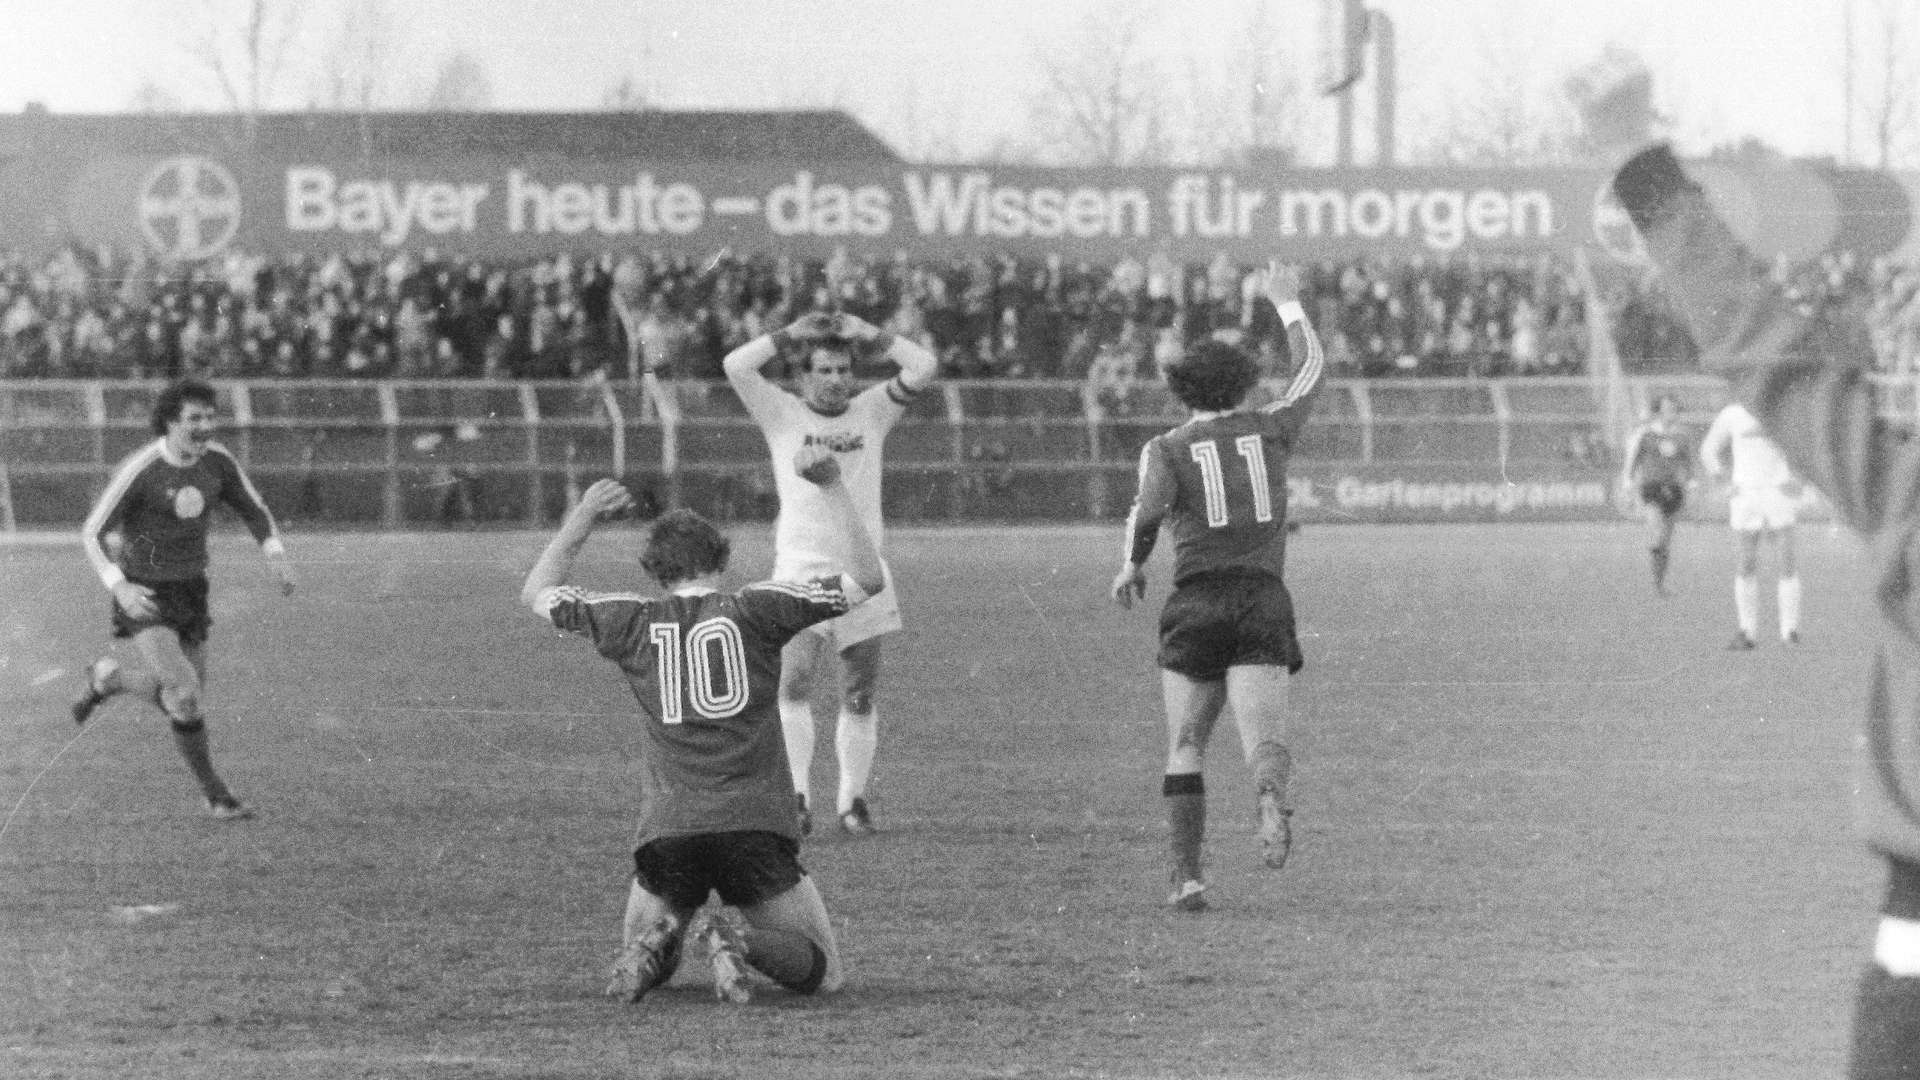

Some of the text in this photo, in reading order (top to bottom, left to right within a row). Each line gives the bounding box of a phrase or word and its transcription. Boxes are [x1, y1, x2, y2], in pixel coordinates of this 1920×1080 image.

[286, 168, 490, 245] Bayer
[506, 168, 704, 235] heute
[766, 170, 892, 236] das
[903, 172, 1152, 238] Wissen
[1168, 174, 1265, 237] für
[1278, 187, 1554, 249] morgen
[1189, 433, 1273, 528] 11
[1335, 477, 1605, 512] Gartenprogramm
[650, 616, 749, 723] 10
